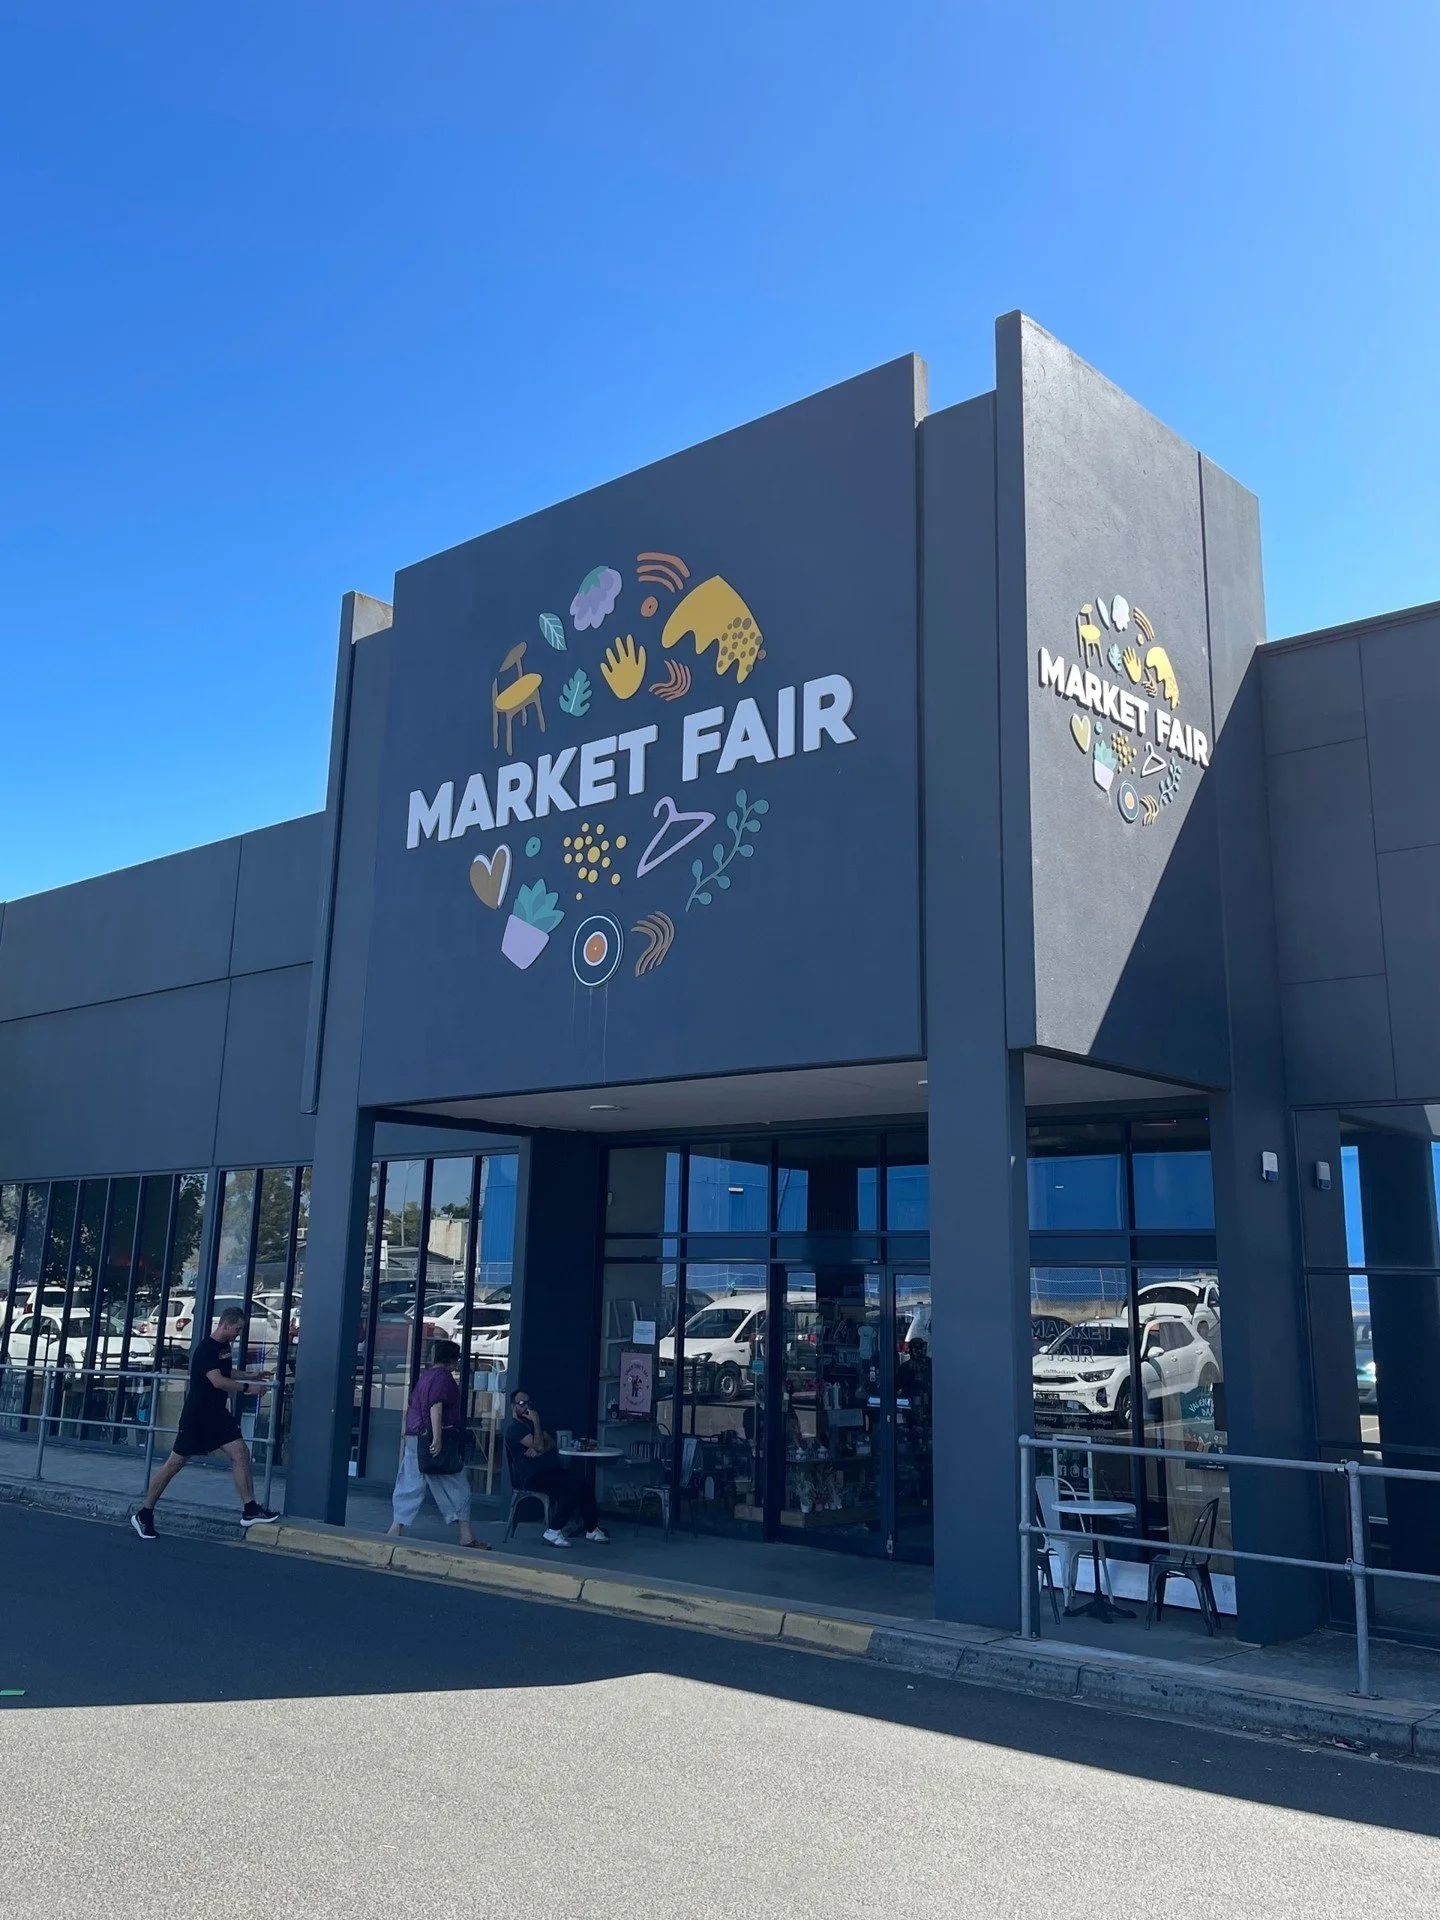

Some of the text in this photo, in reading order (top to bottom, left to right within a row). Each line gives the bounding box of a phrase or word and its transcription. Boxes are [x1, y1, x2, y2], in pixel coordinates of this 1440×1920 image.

[1039, 646, 1211, 767] MARKET FAIR
[406, 673, 858, 850] MARKET FAIR
[1031, 1319, 1113, 1341] MARKET
[1035, 1414, 1057, 1422] Thursday
